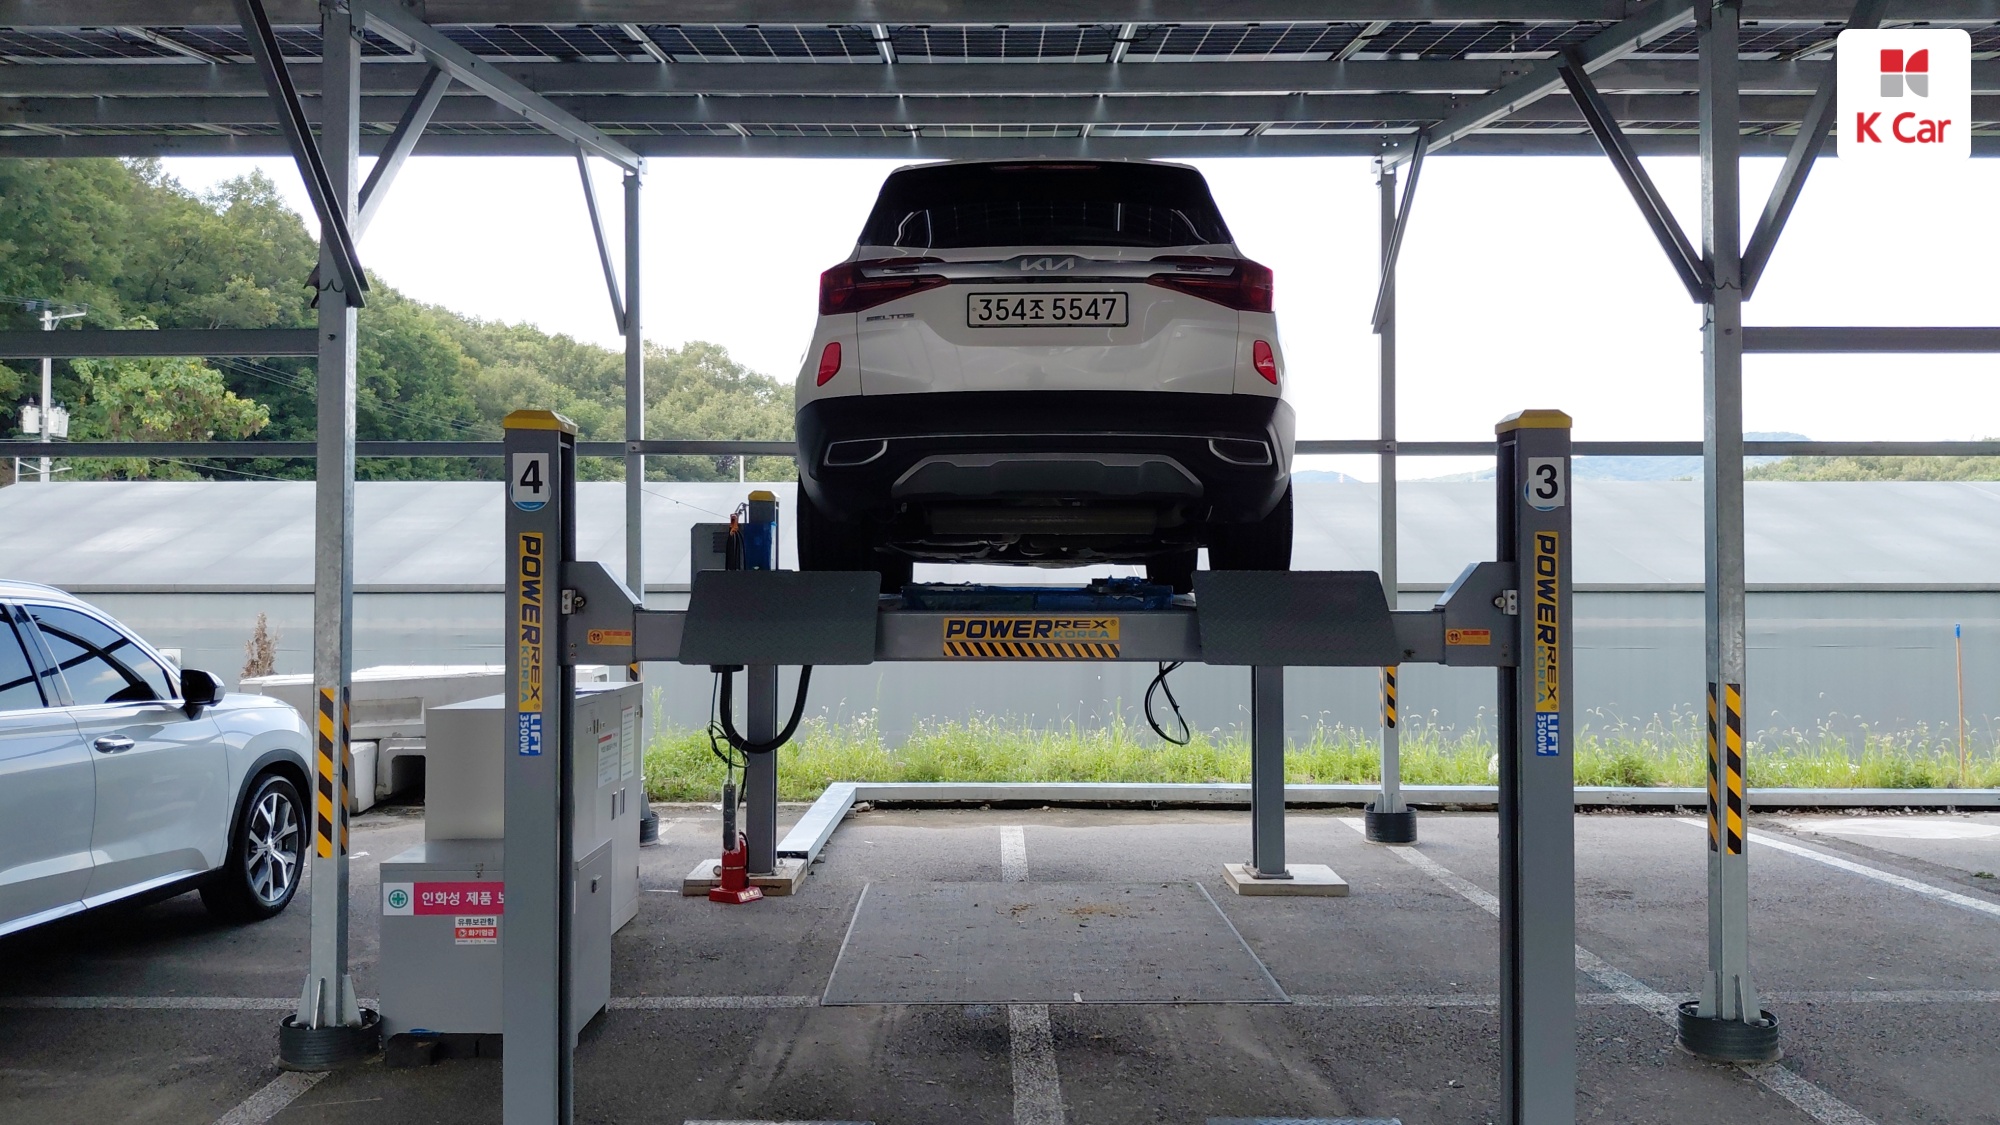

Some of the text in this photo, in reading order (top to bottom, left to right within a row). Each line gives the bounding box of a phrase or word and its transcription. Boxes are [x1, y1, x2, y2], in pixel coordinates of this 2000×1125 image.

[978, 298, 1117, 321] 354조 5547
[520, 460, 543, 494] 4
[1535, 464, 1558, 499] 3
[1053, 630, 1110, 639] KOREA
[520, 646, 530, 703] KOREA
[1537, 646, 1546, 703] KOREA
[520, 714, 530, 754] 3500W
[530, 714, 542, 754] LIFT
[1537, 714, 1547, 754] 3500W
[1547, 714, 1559, 754] LIFT
[421, 891, 460, 906] 인화성
[466, 891, 493, 906] 제품
